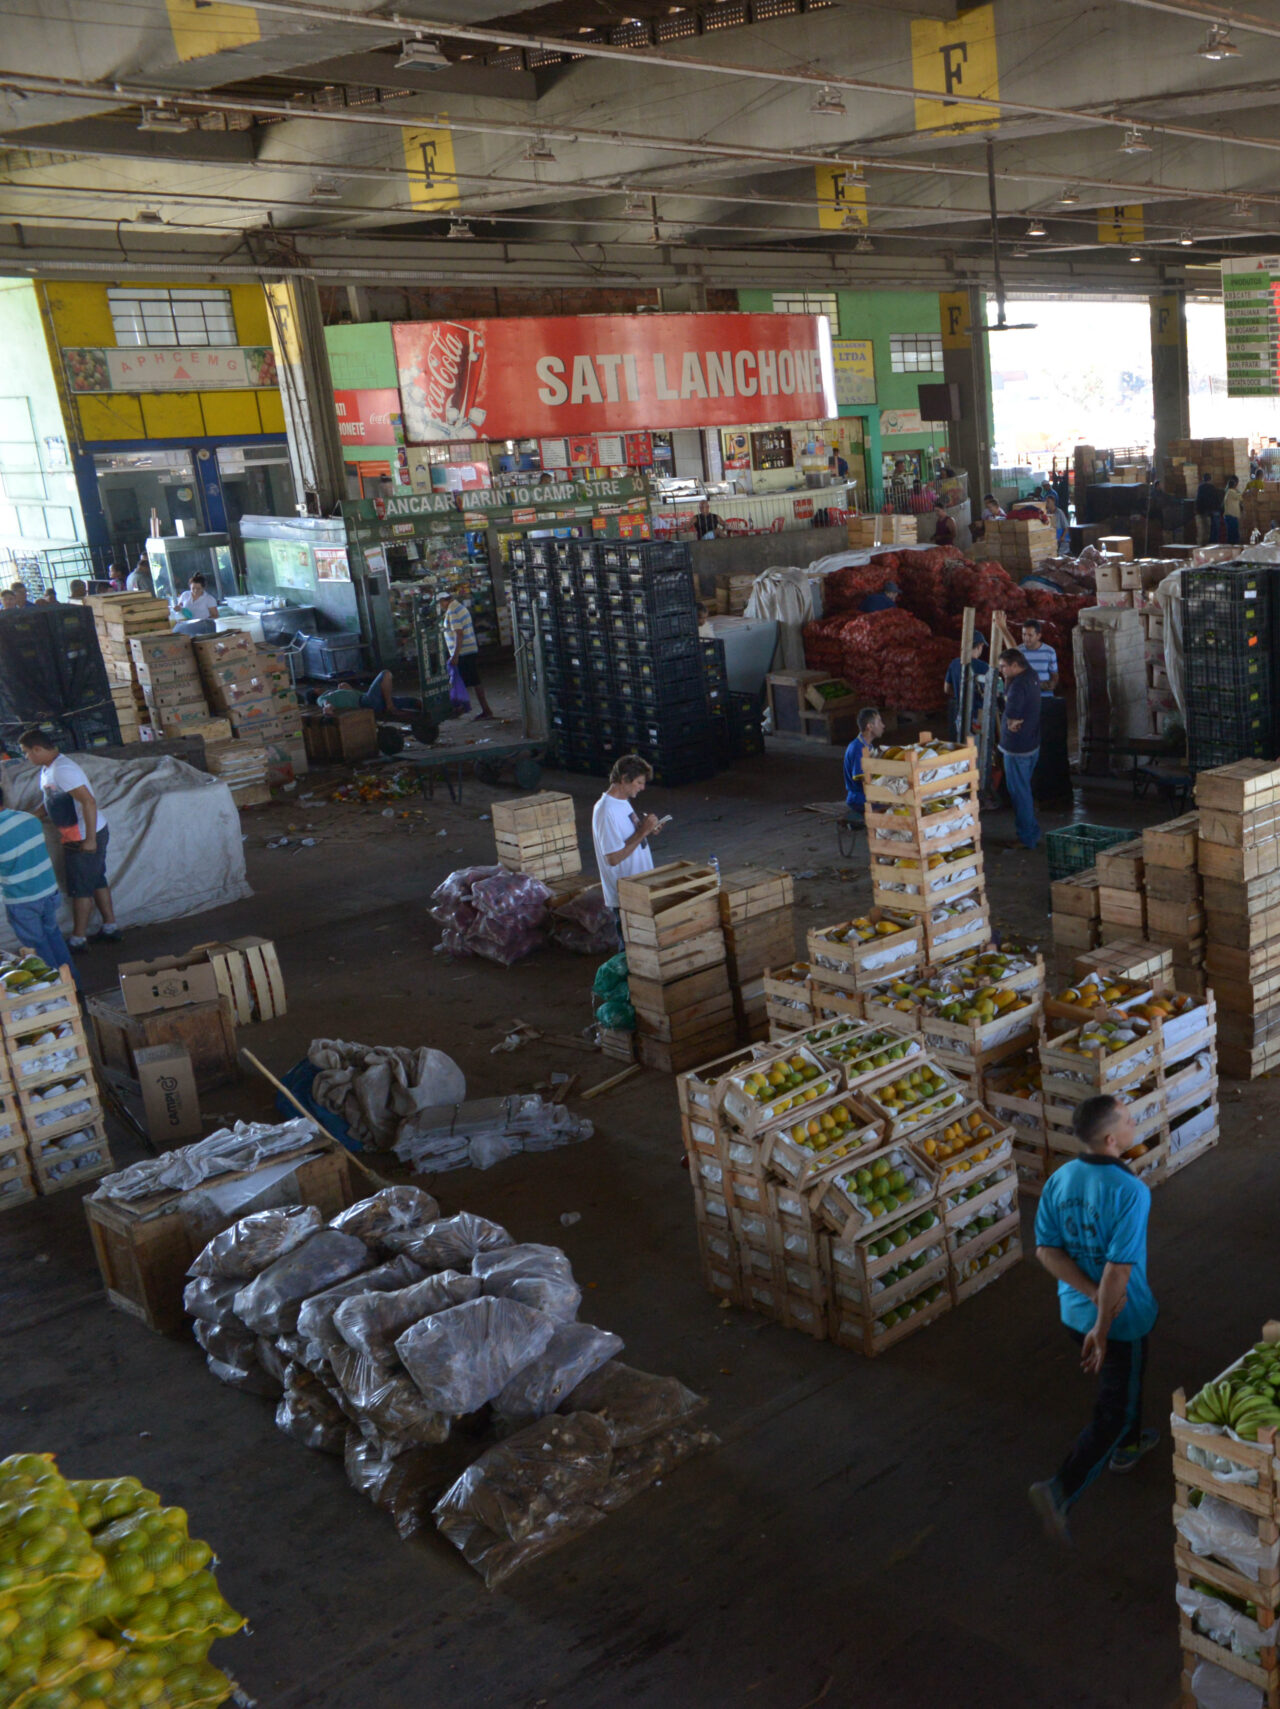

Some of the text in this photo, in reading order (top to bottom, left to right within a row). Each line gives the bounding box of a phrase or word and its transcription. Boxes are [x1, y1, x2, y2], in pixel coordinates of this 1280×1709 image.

[939, 41, 967, 106] F
[419, 140, 437, 189] F
[948, 306, 961, 335] F
[1157, 308, 1170, 333] F
[120, 351, 237, 373] APHCEMG
[428, 325, 463, 418] ca-Cola
[838, 352, 867, 361] LTDA
[535, 350, 822, 406] SATI LANCHONE
[335, 402, 347, 416] ATI
[374, 495, 433, 517] ANCA
[533, 480, 621, 502] CAMPSTRE
